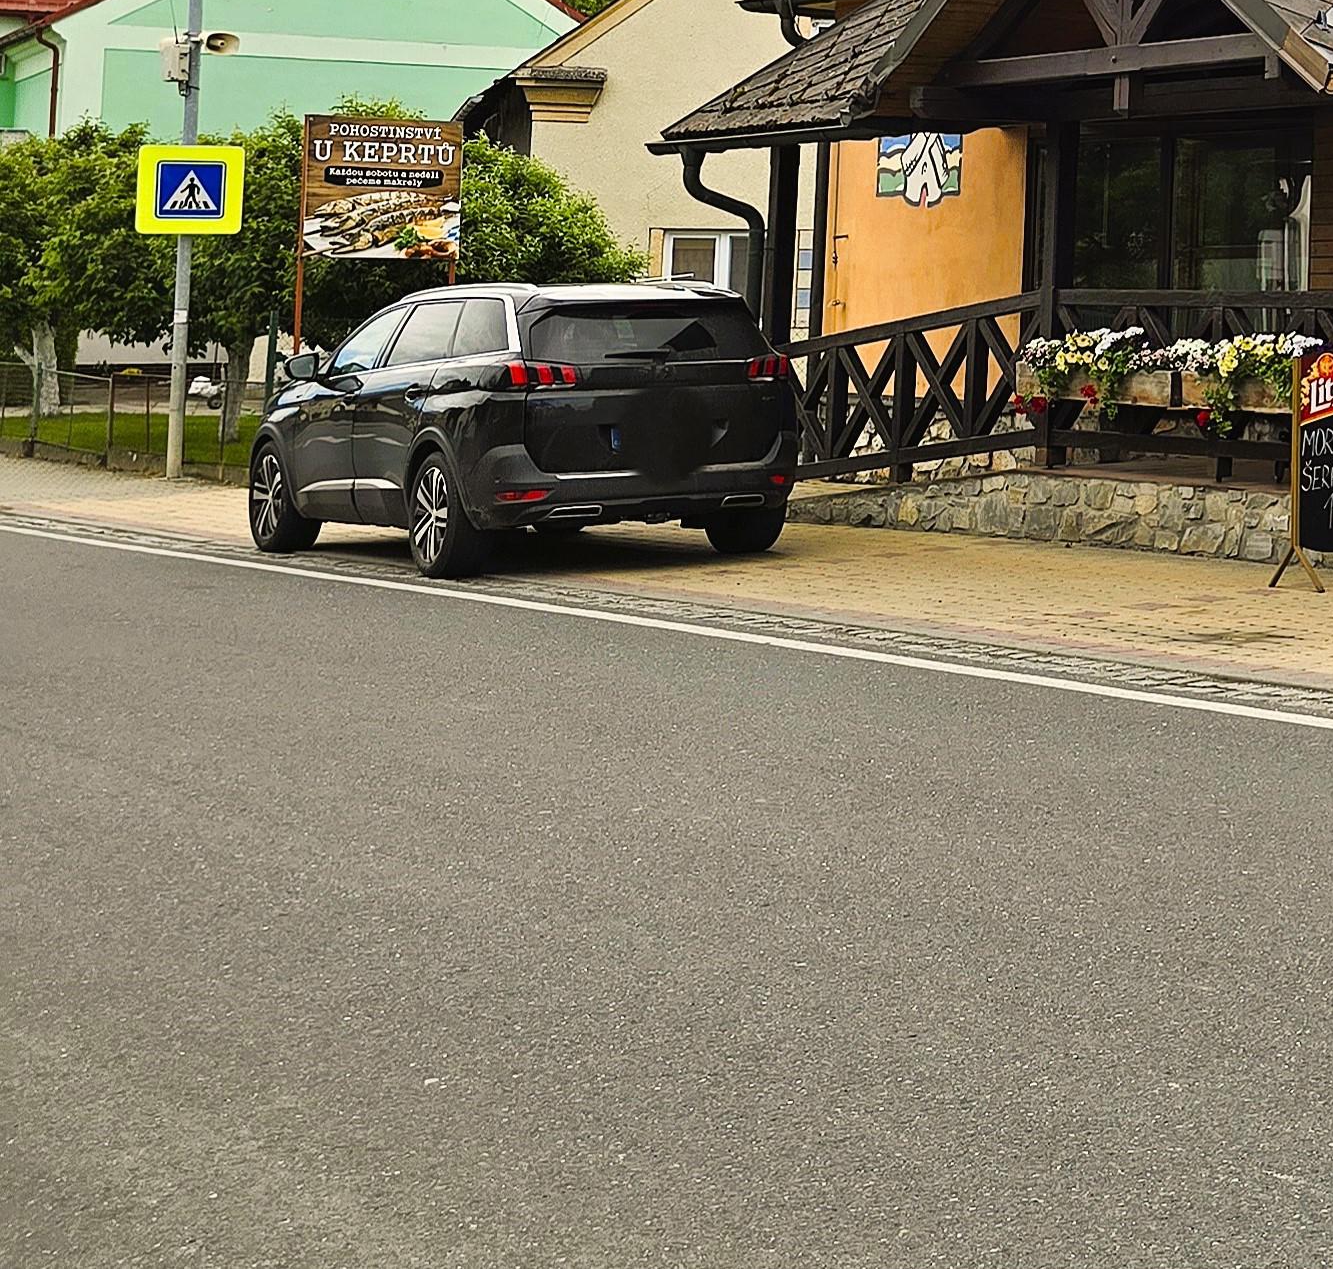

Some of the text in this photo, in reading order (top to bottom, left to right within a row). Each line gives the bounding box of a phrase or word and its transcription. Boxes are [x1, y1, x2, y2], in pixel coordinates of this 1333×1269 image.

[329, 123, 442, 141] POHOSTINSTVÍ
[313, 140, 456, 166] U KEPRTŮ
[329, 167, 440, 180] Každou sobotu a neděli
[346, 177, 423, 189] pečeme makrely
